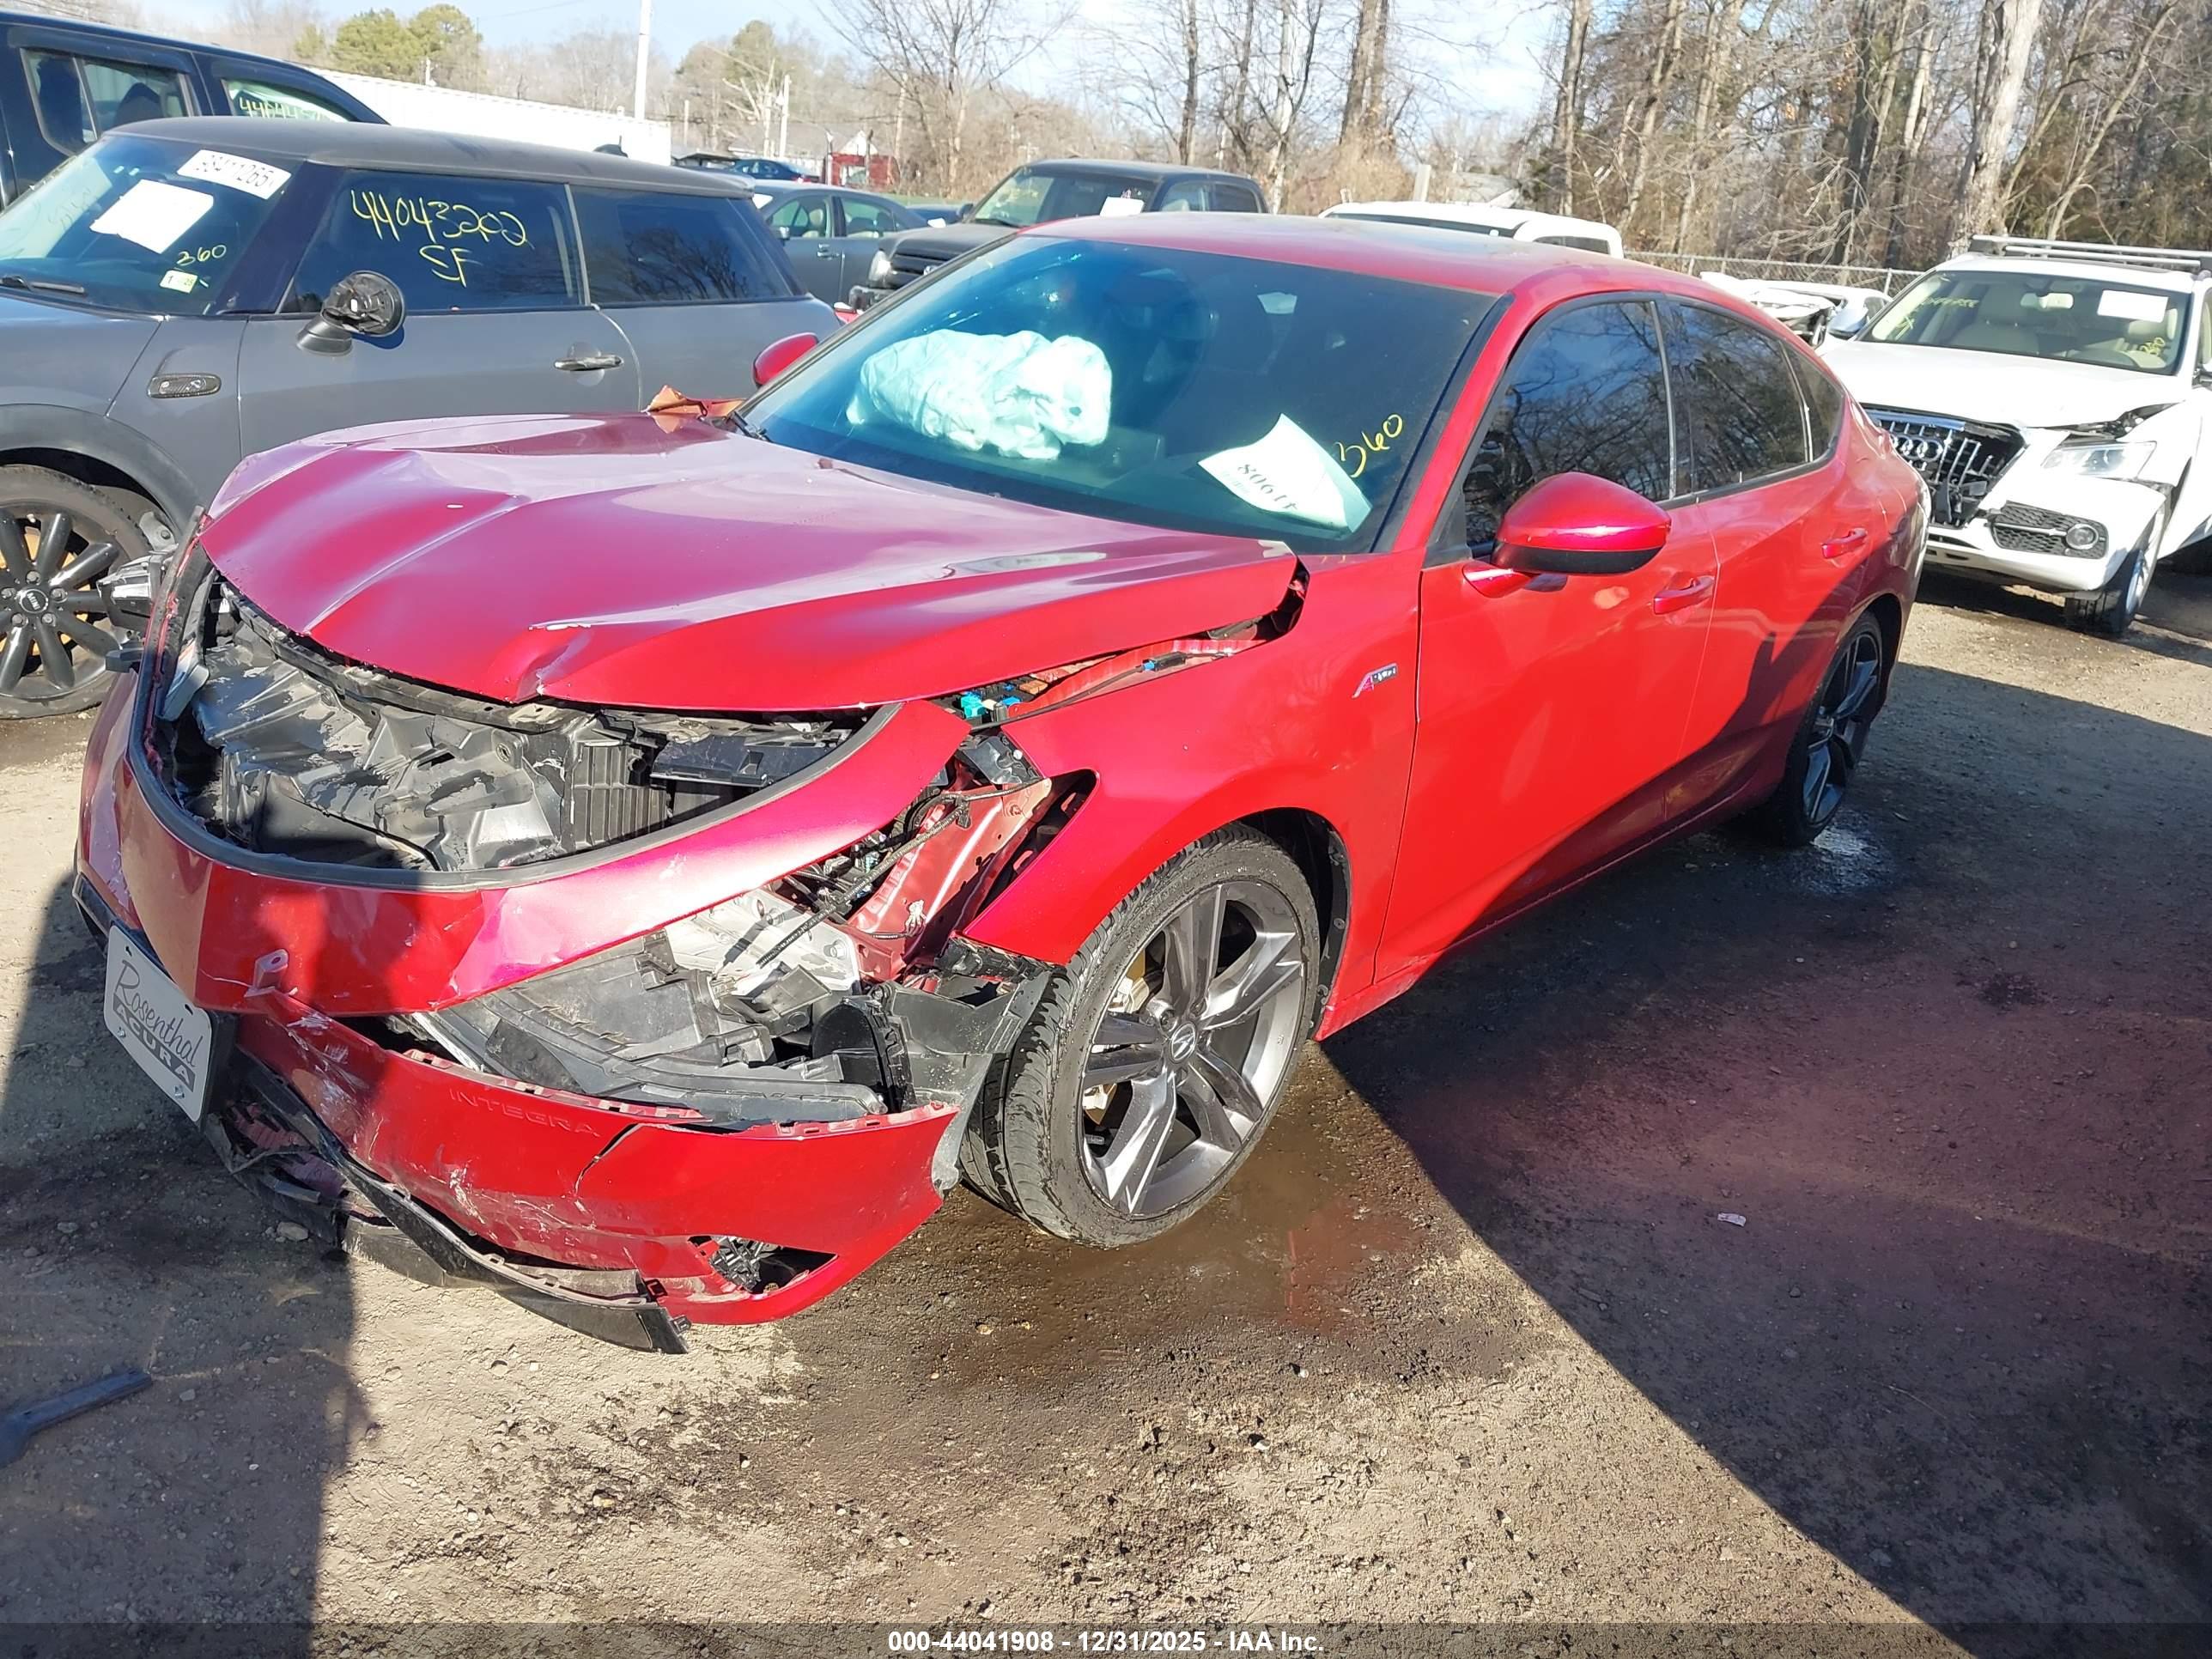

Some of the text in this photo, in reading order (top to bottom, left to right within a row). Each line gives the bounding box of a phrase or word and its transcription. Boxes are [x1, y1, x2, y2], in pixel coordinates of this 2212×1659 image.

[350, 189, 535, 250] 44043202
[419, 245, 483, 288] SF
[27, 592, 41, 611] MINI
[114, 959, 204, 1068] Rosenthal
[115, 1004, 191, 1085] ACURA
[449, 1087, 601, 1138] INTEGRA
